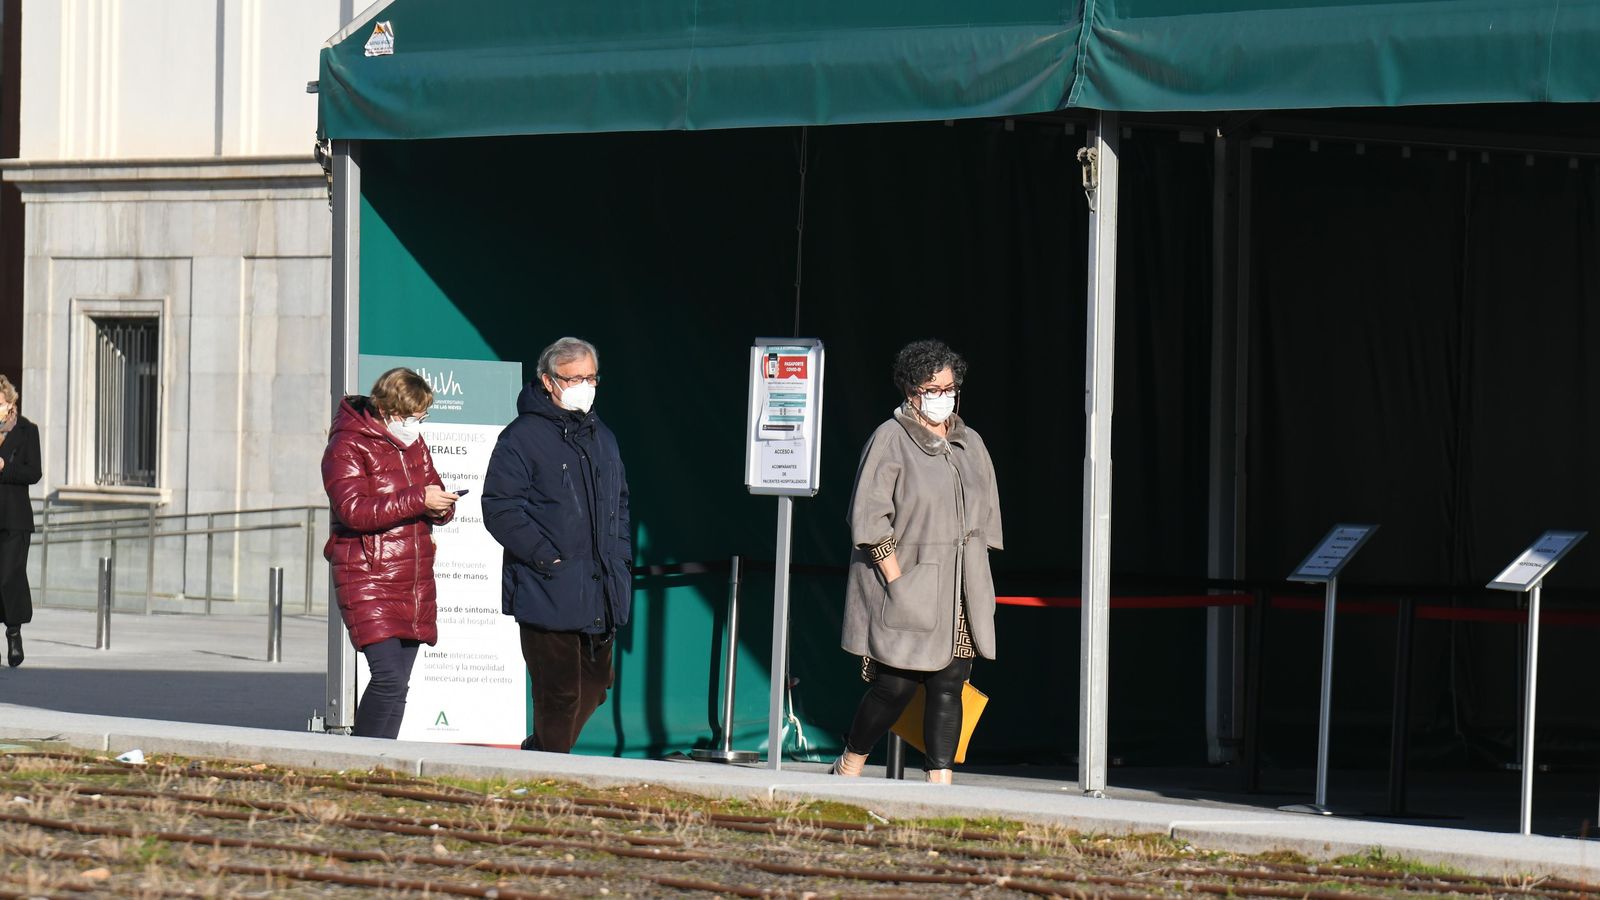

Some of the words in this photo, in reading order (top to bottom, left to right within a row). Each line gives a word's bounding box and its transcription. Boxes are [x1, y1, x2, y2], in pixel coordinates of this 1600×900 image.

[452, 571, 462, 579] de
[463, 573, 489, 581] manos
[453, 605, 463, 613] de
[467, 617, 496, 627] hospital
[455, 664, 460, 672] y
[461, 663, 468, 671] la
[469, 663, 505, 672] movilidad
[466, 677, 479, 685] por
